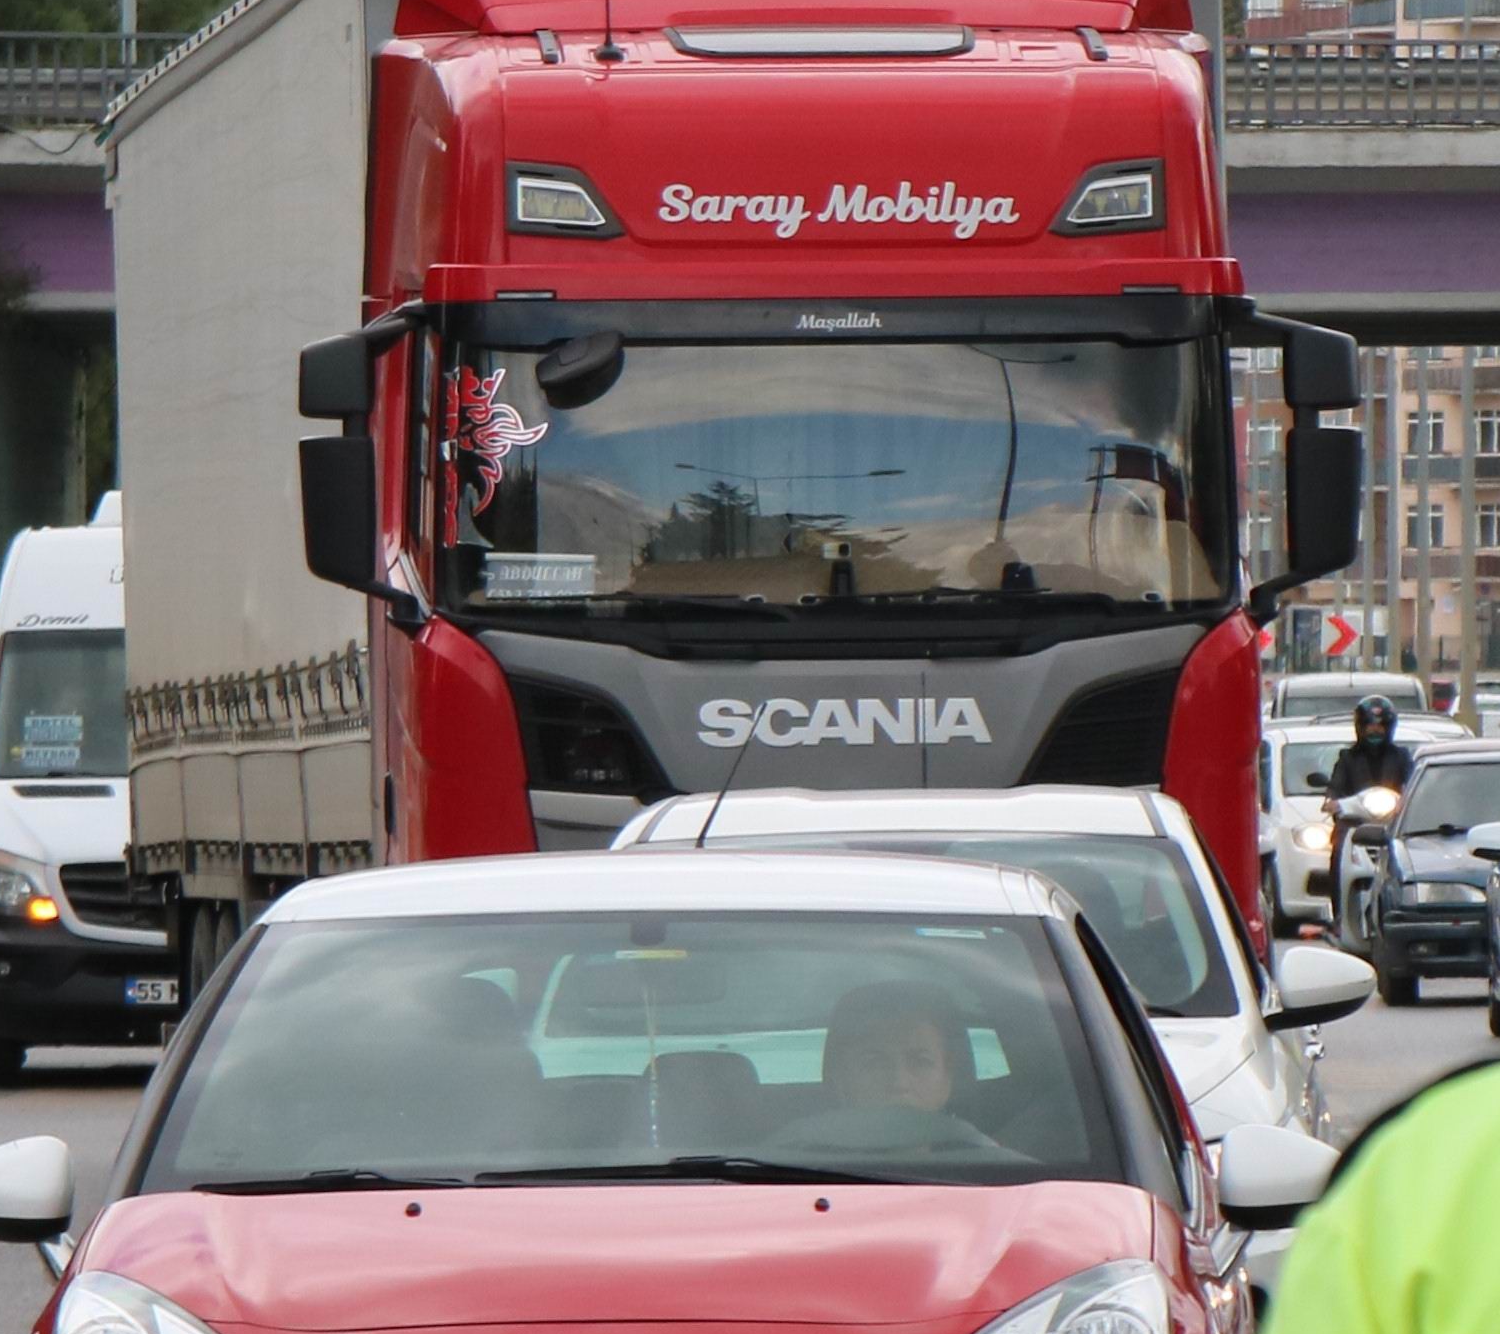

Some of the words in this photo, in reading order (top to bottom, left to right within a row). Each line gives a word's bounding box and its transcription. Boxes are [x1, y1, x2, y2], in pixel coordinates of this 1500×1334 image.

[658, 183, 811, 240] Saray
[816, 181, 1020, 240] Mobilya
[795, 312, 882, 333] Maşallah
[697, 697, 993, 748] SCANIA
[137, 982, 162, 1002] 55
